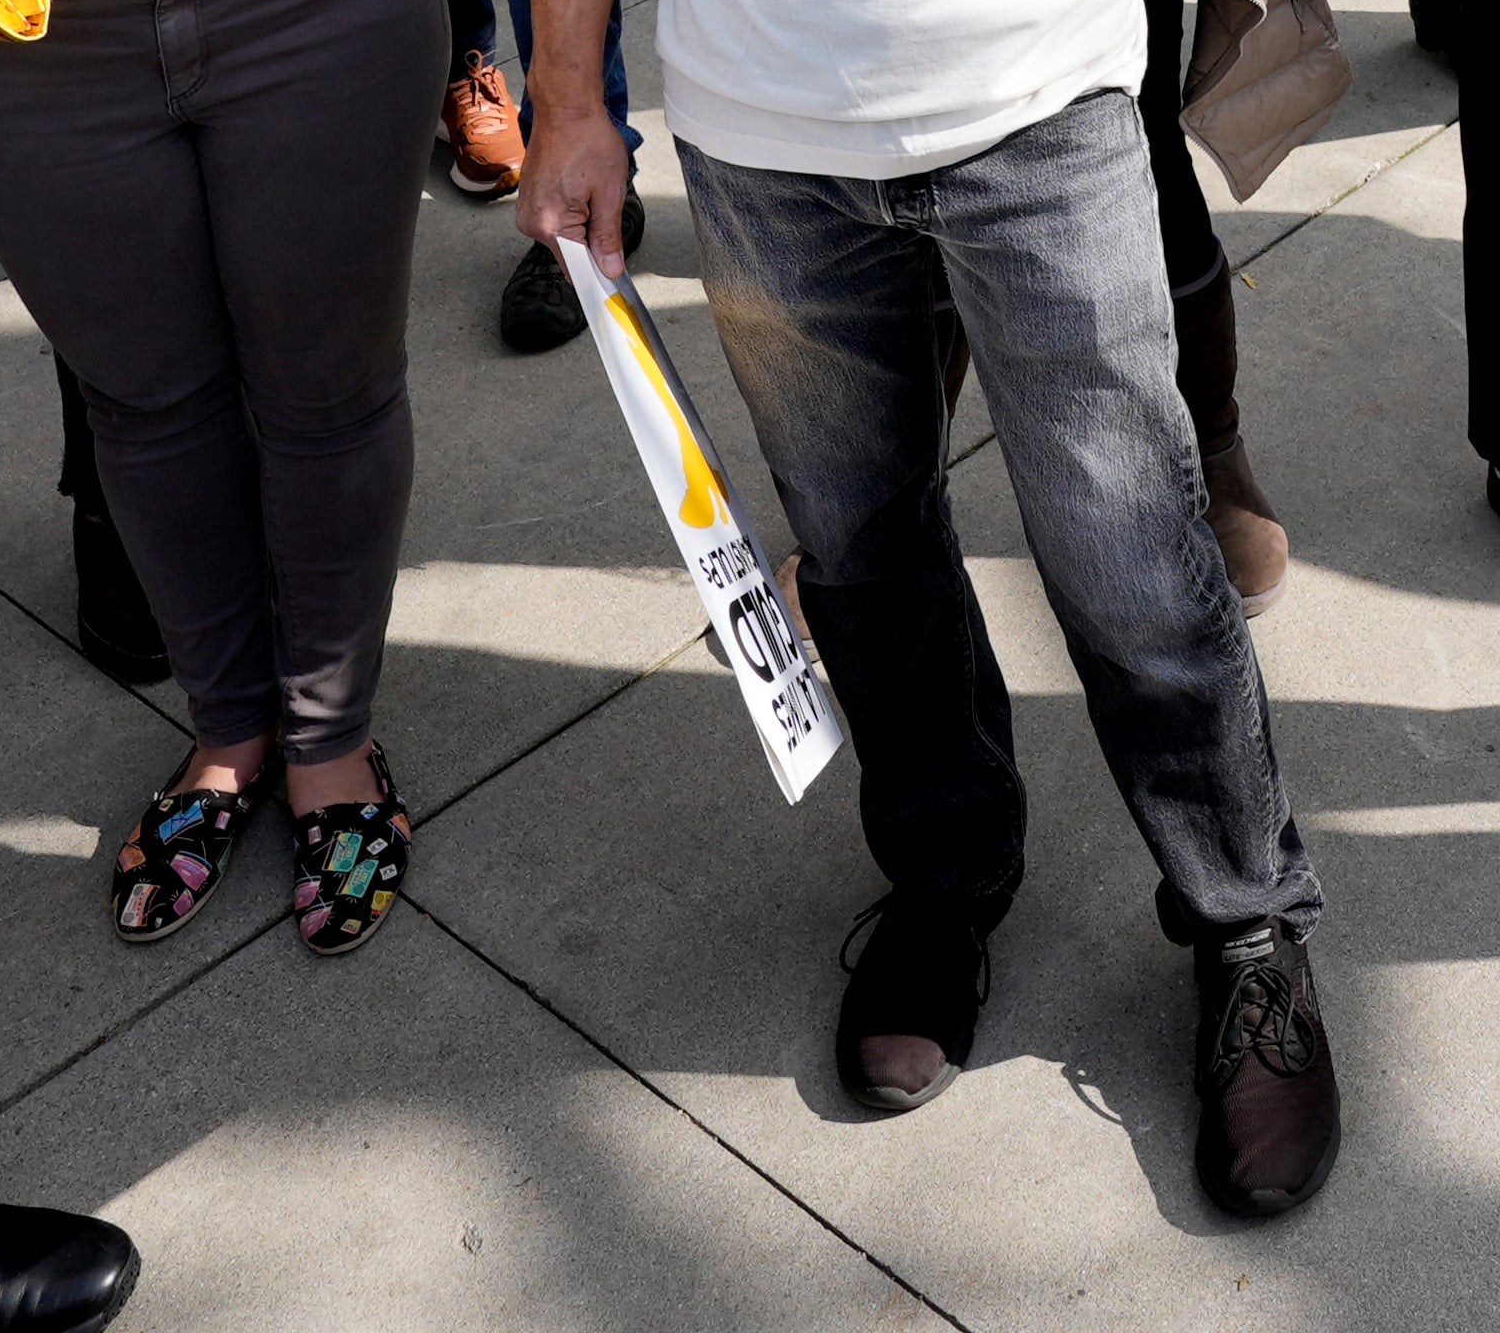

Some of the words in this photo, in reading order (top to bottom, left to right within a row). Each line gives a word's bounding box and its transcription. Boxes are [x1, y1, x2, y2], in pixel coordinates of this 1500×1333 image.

[699, 546, 733, 589] ULPs
[729, 581, 798, 683] GUILD
[772, 680, 812, 753] TIMES
